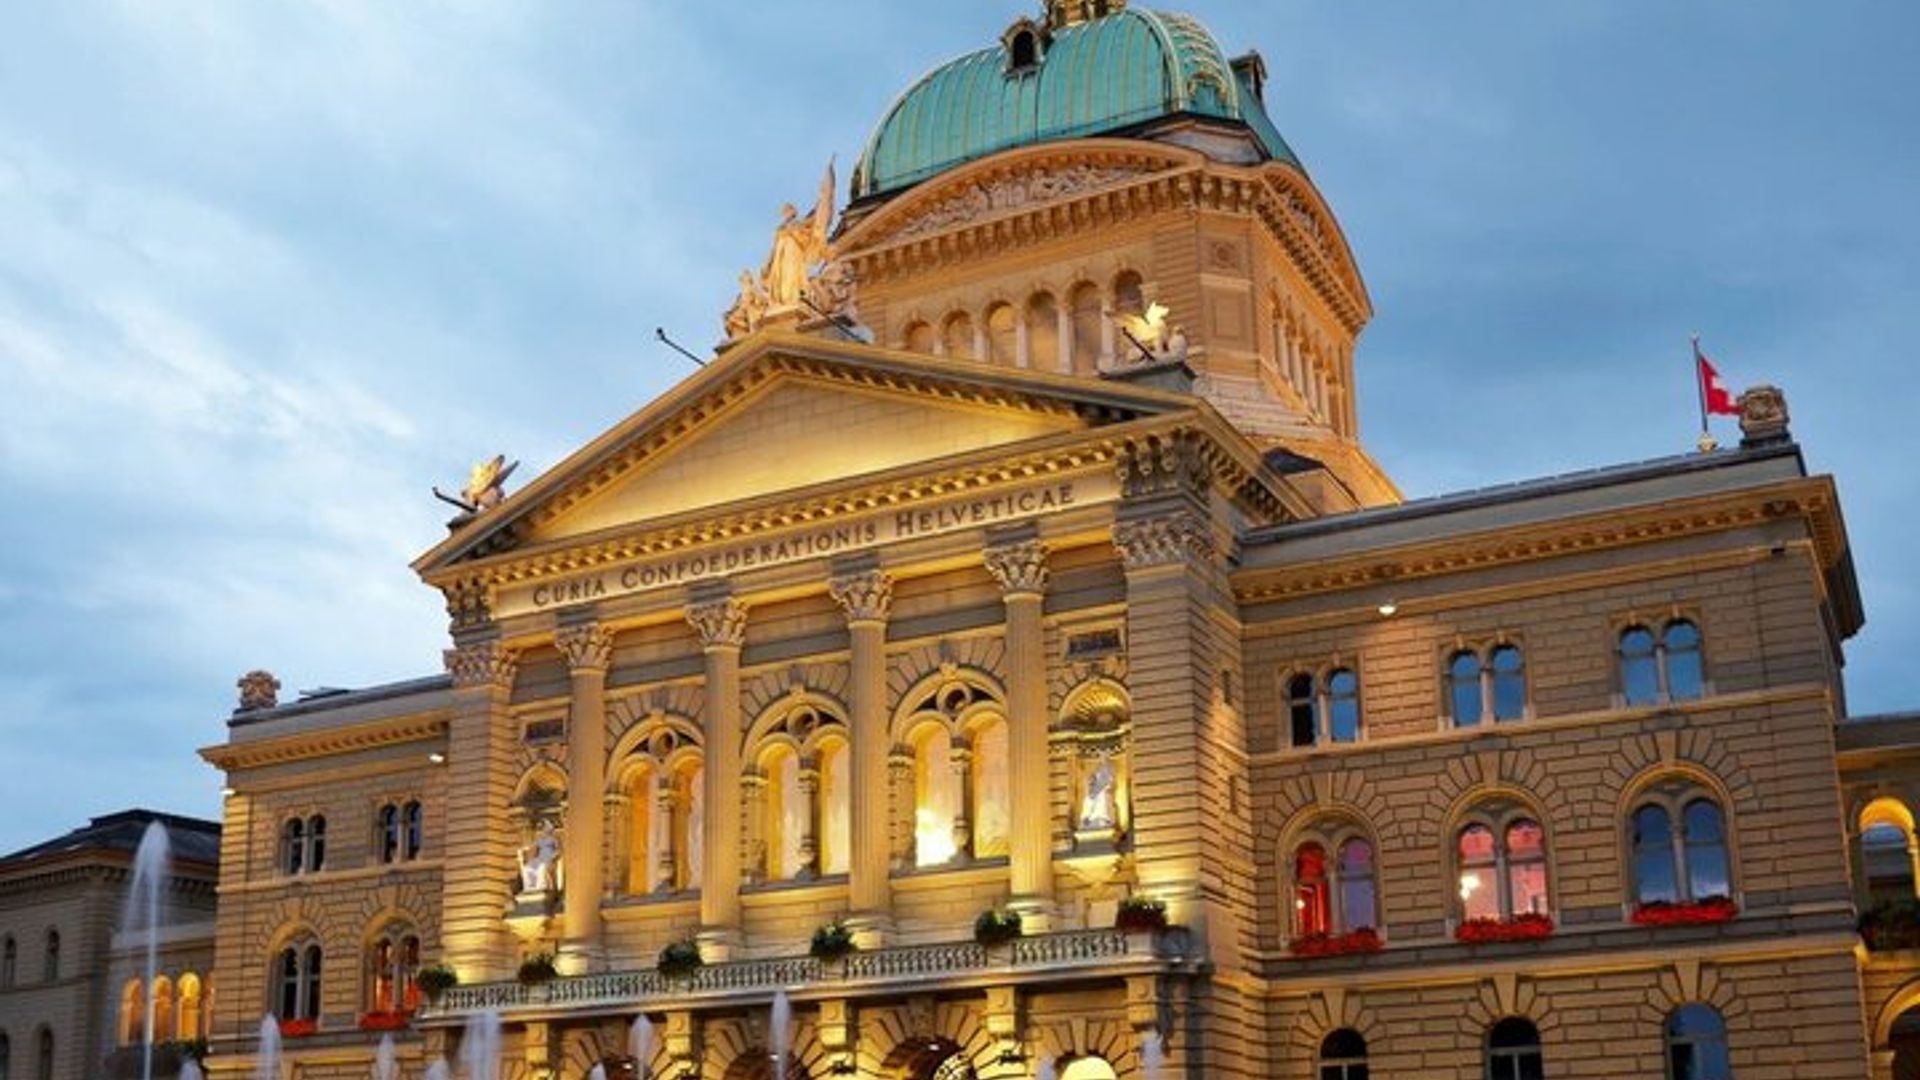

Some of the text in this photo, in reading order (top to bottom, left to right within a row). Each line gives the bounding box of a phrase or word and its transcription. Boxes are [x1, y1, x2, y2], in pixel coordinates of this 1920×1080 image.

[533, 484, 1075, 607] CURIA CONFOEDERATIONIS HELVETICAE
